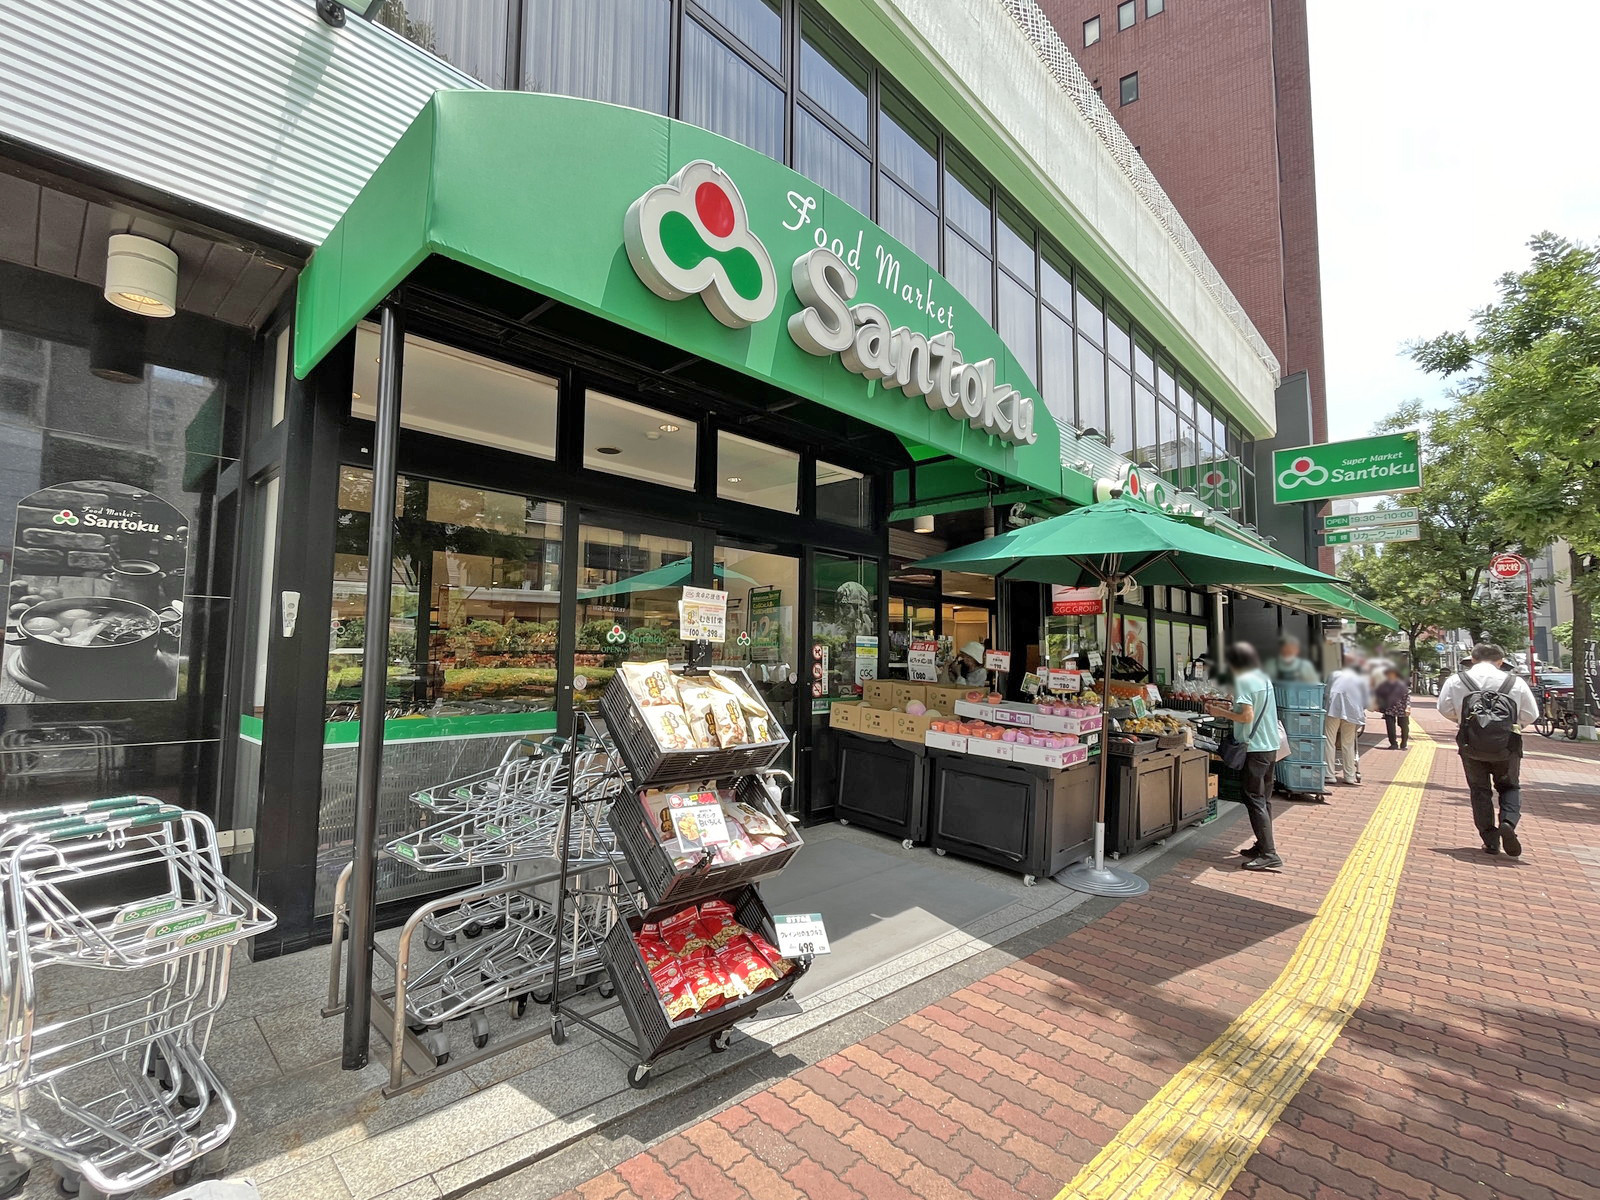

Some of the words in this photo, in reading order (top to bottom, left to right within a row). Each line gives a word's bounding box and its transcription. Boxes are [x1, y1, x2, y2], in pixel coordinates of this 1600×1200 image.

[782, 190, 864, 271] Food
[876, 245, 954, 331] Market
[788, 246, 1038, 447] Santoku
[1342, 457, 1367, 466] Super
[1369, 452, 1403, 462] Market
[1331, 462, 1415, 483] Santoku
[81, 506, 104, 515] Food
[105, 508, 135, 518] Market
[83, 513, 160, 532] Santoku
[1327, 517, 1348, 526] OPEN
[1353, 528, 1413, 540] リカーワールド
[1497, 562, 1519, 572] 消火栓
[1053, 606, 1071, 614] CGC
[1072, 605, 1100, 613] GROUP
[860, 668, 873, 678] CGC
[141, 904, 173, 917] Santoku
[172, 918, 205, 932] Santoku
[203, 926, 234, 939] Santoku
[799, 942, 815, 953] 498
